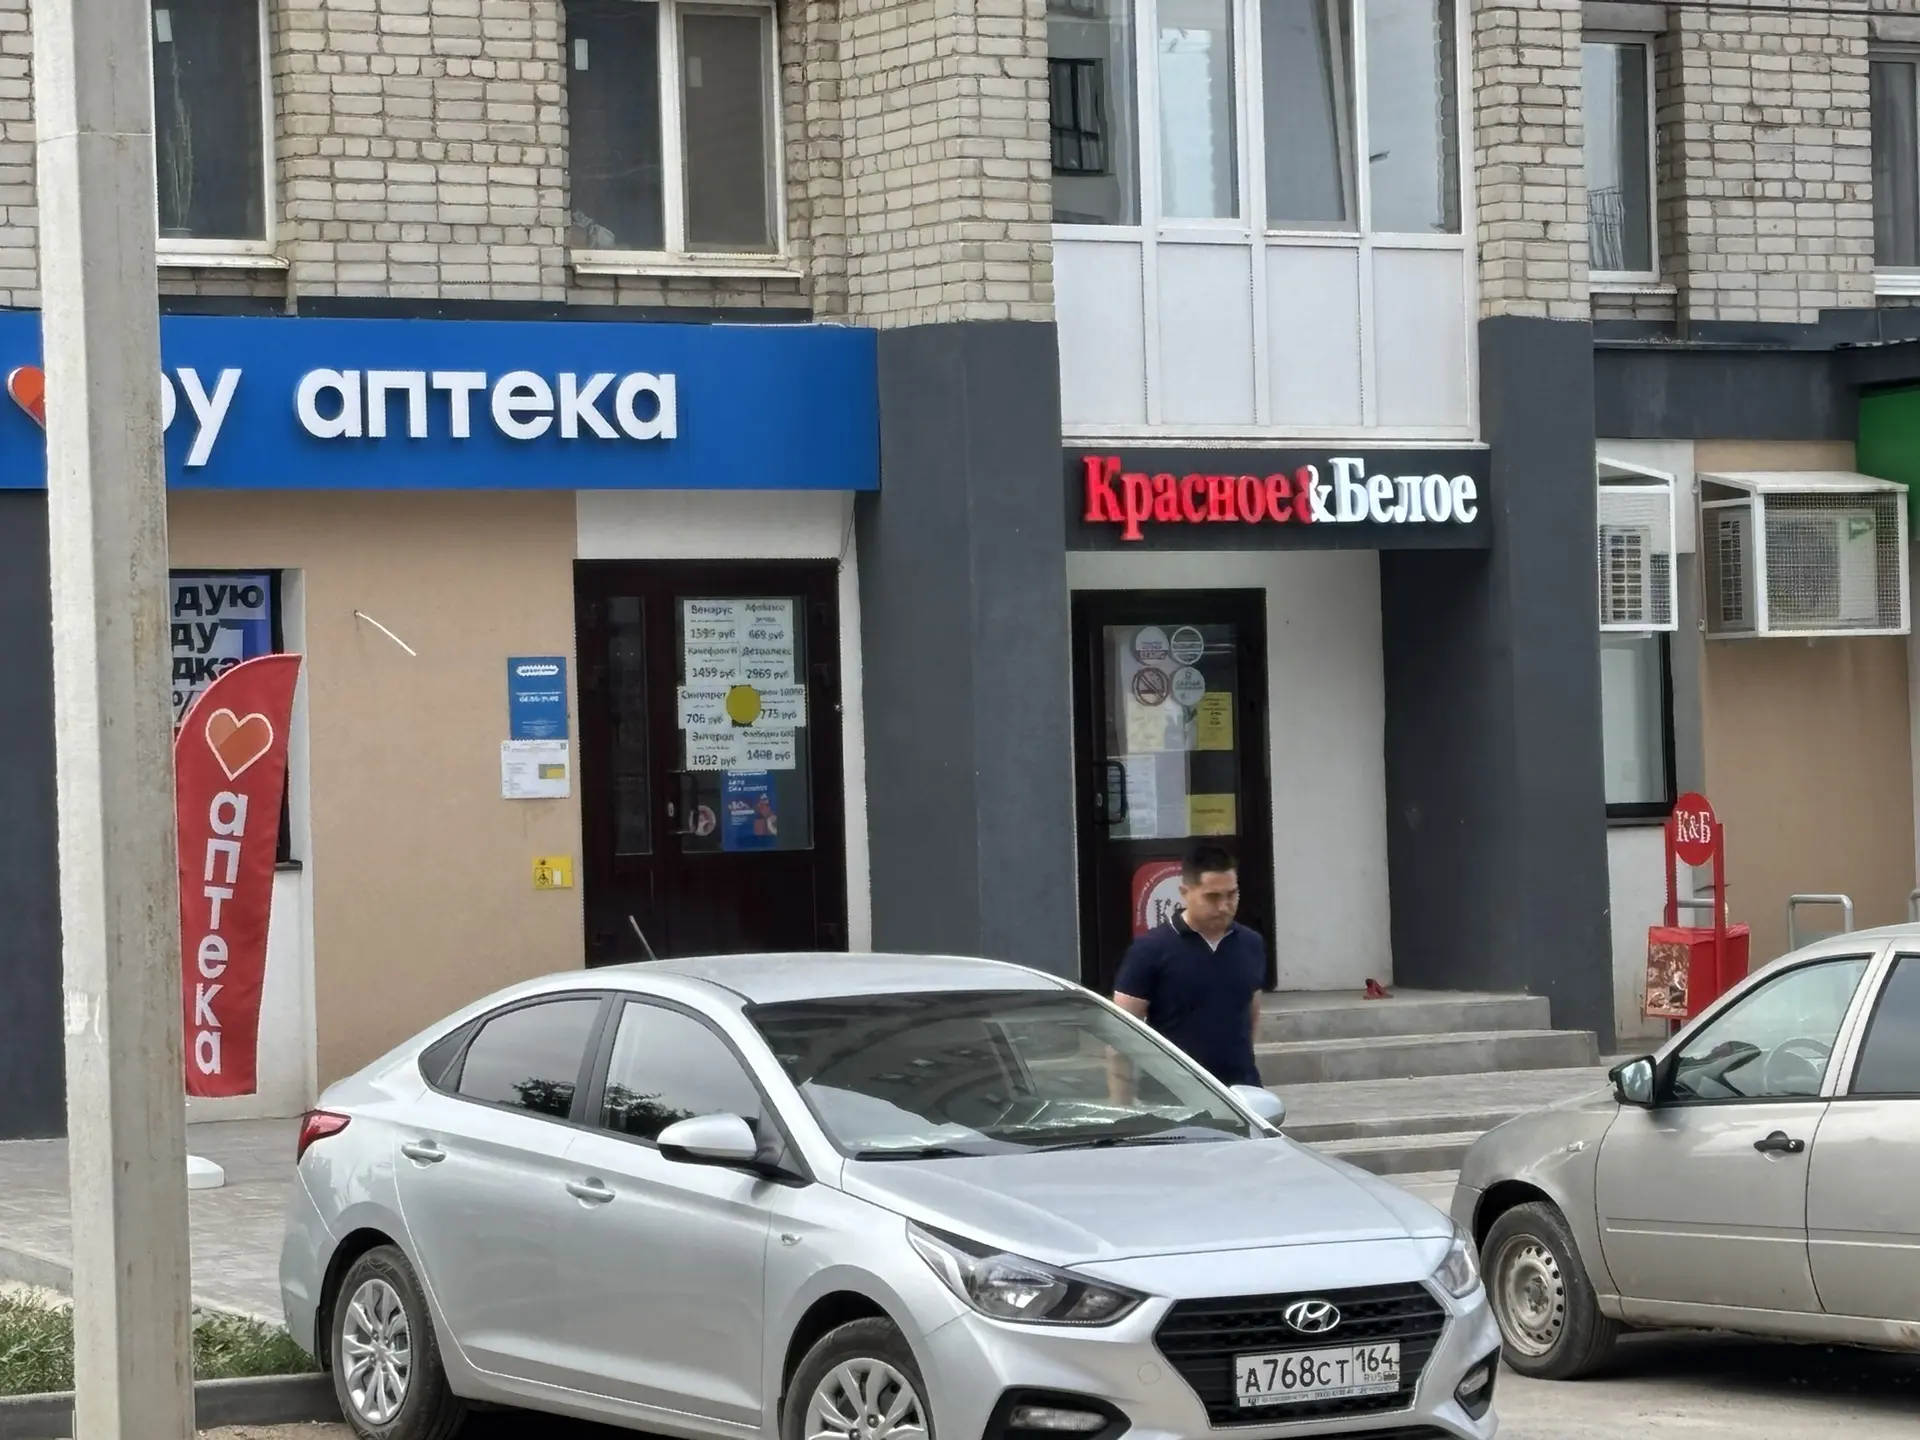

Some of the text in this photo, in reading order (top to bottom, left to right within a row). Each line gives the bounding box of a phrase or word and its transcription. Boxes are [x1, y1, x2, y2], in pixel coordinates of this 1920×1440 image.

[297, 368, 677, 440] аптека
[1083, 455, 1479, 541] Красное&Белое
[691, 604, 733, 616] Венарус
[1675, 810, 1712, 844] К&Б
[195, 790, 249, 1076] аптека
[1355, 1346, 1394, 1374] 164
[1363, 1371, 1384, 1382] RUS
